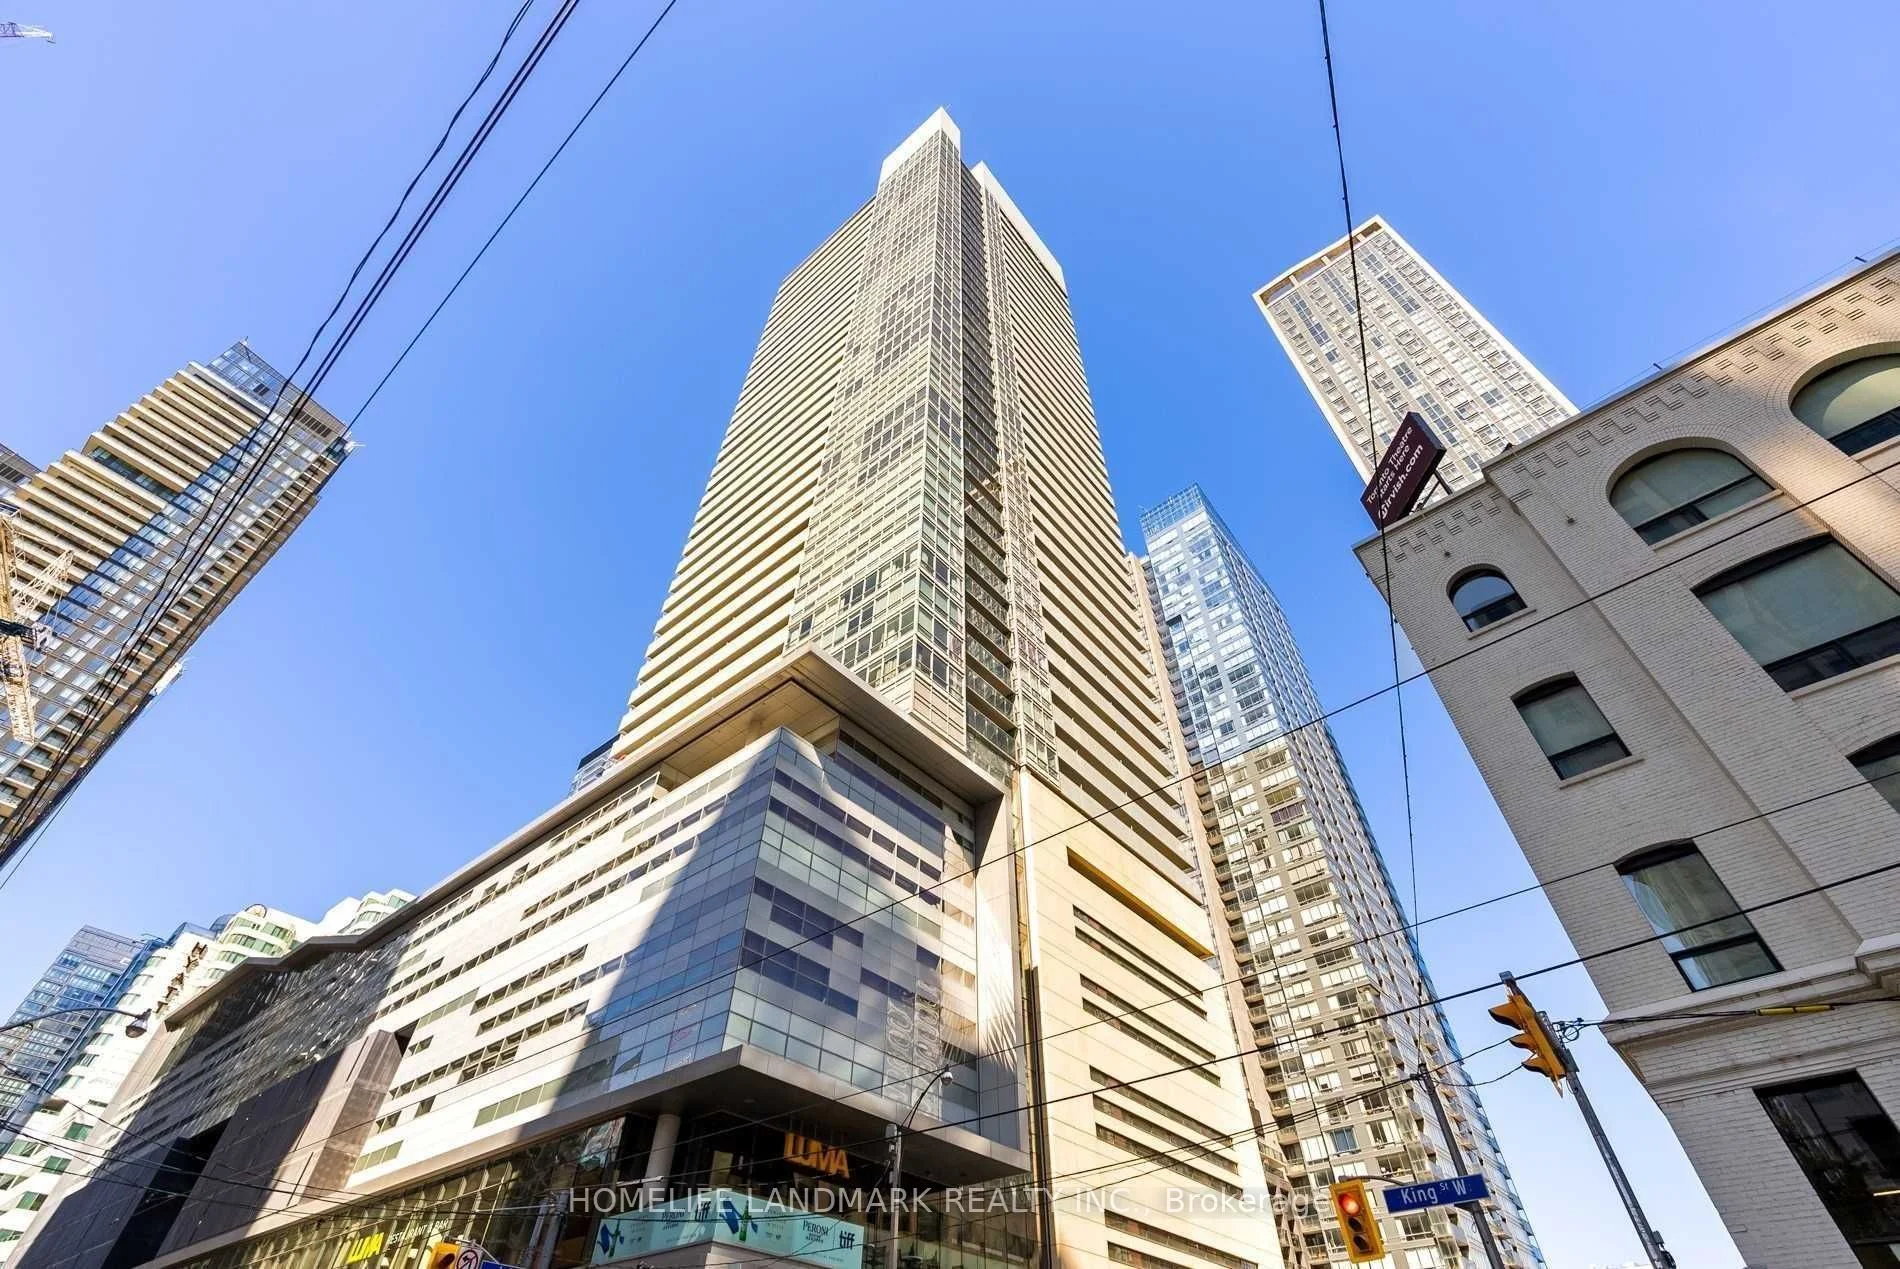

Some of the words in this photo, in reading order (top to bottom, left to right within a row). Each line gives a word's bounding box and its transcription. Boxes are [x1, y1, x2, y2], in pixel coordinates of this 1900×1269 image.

[1367, 467, 1389, 504] Tornto
[1388, 426, 1413, 466] Theatre
[1394, 445, 1410, 471] Here
[155, 942, 208, 1014] HYATT
[784, 1133, 849, 1179] LUMA
[1401, 1187, 1438, 1205] King
[1440, 1182, 1449, 1191] St
[1452, 1179, 1466, 1196] W
[803, 1219, 829, 1236] PERONI
[840, 1230, 855, 1250] tiff
[346, 1232, 384, 1264] LUMA
